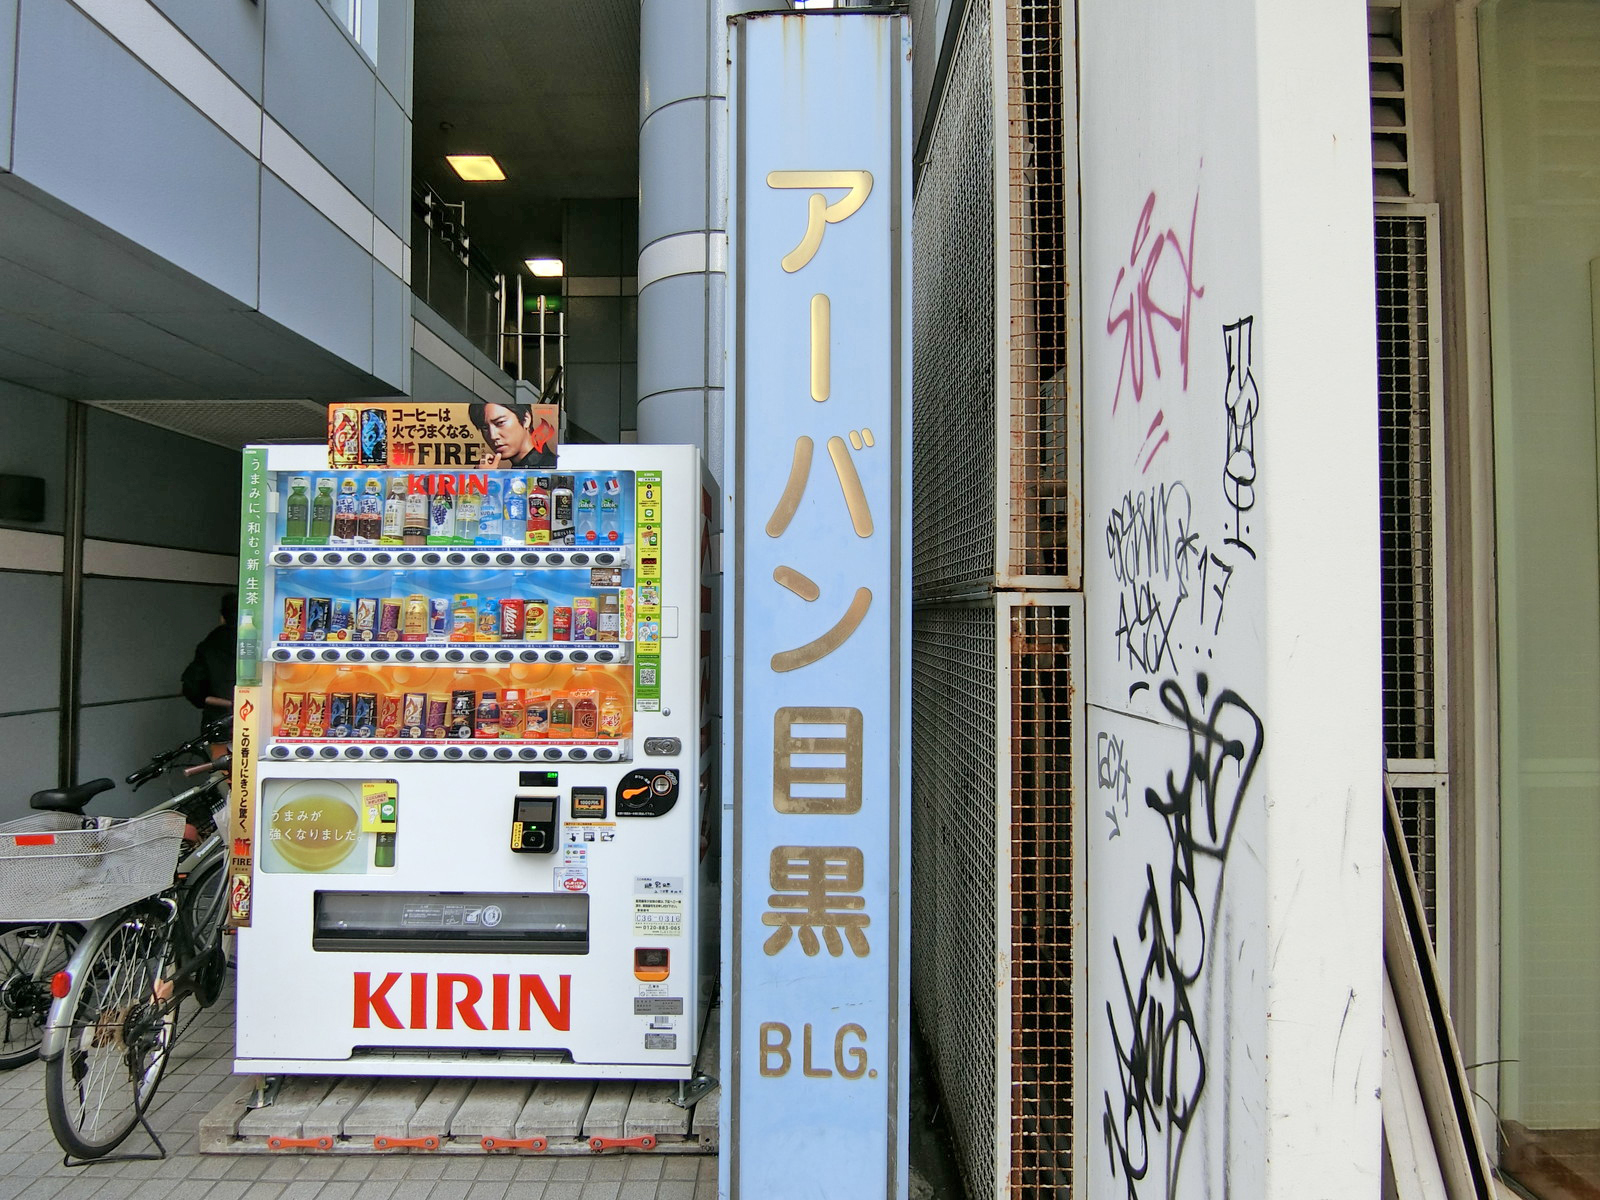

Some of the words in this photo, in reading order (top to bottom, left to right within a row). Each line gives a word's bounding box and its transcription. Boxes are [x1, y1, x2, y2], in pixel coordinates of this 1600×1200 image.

[392, 408, 451, 423] コーヒーは
[392, 424, 475, 439] 火でうまくなる。
[407, 474, 489, 496] KIRIN
[761, 170, 875, 958] アーバン目黒
[505, 606, 519, 634] Mets
[271, 810, 323, 822] うまみが
[269, 828, 361, 841] 強くなりました。
[232, 857, 252, 866] FIRE
[352, 971, 572, 1032] KIRIN
[759, 1022, 878, 1080] BLG.
